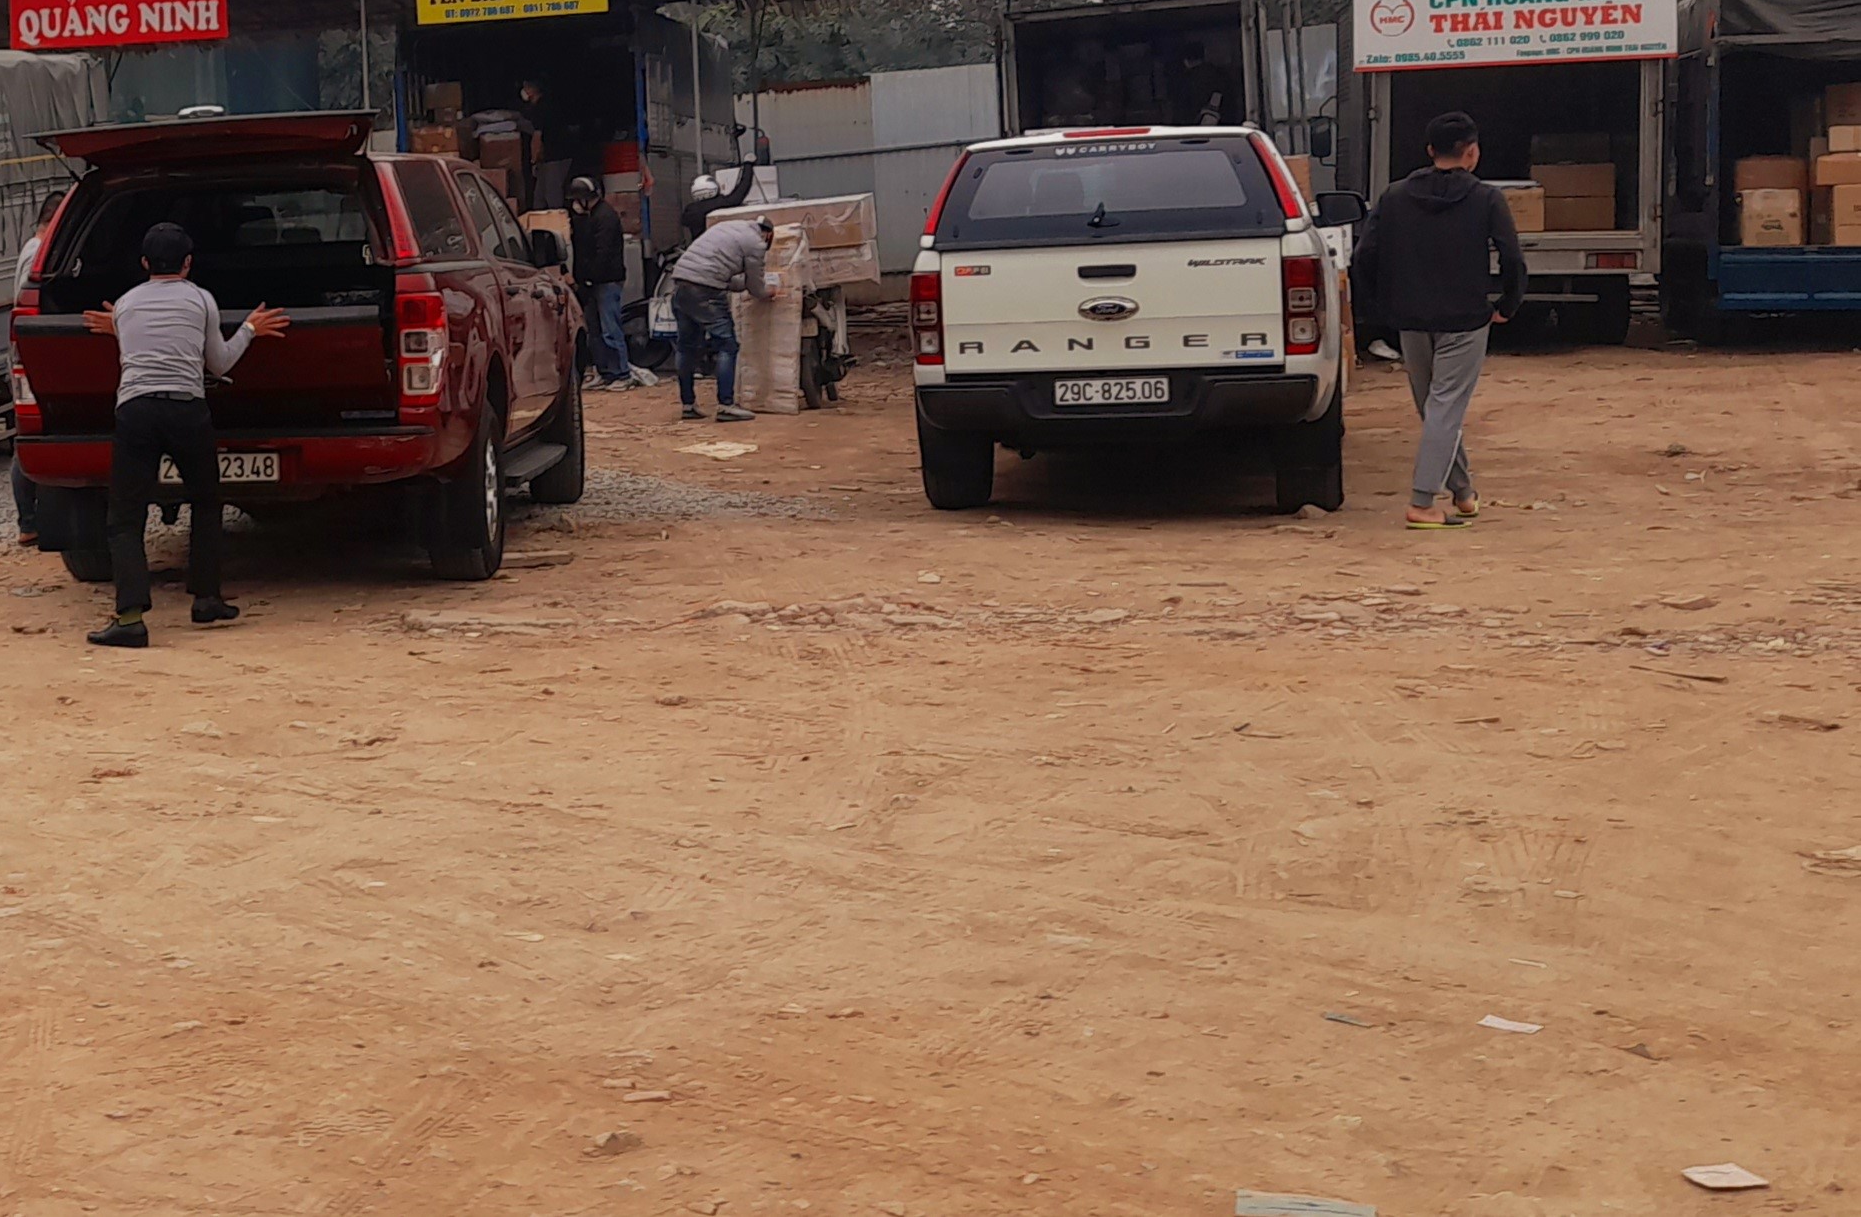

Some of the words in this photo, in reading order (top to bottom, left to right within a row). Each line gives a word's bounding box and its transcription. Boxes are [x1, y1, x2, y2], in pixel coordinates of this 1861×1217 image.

[138, 0, 220, 33] NINH
[1429, 7, 1504, 33] THÁI
[1513, 1, 1644, 30] NGUYÊN
[1366, 54, 1392, 64] Zalo:
[1078, 143, 1156, 154] CARRYBOY
[959, 332, 1268, 355] RANGER
[1058, 381, 1166, 403] 29C-825.06
